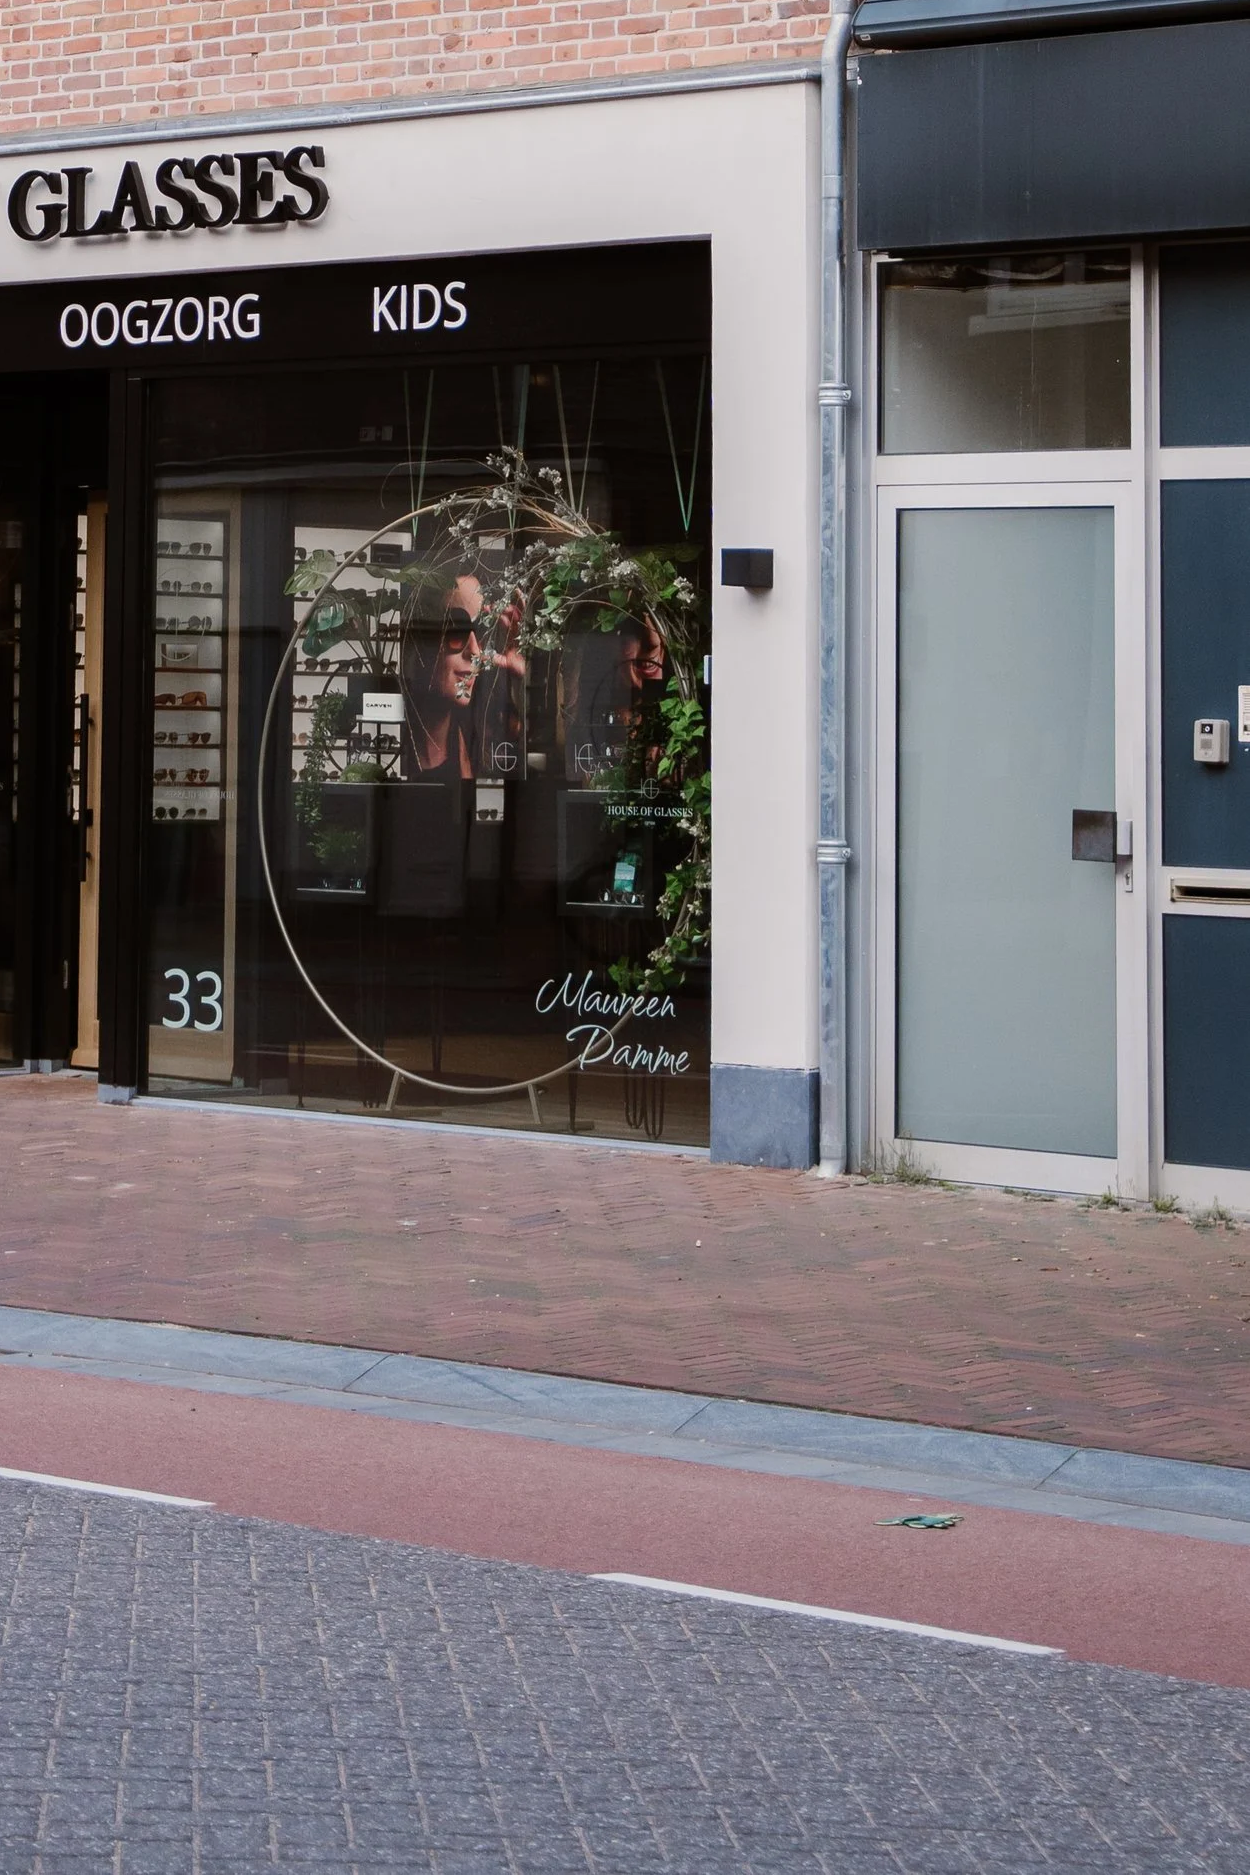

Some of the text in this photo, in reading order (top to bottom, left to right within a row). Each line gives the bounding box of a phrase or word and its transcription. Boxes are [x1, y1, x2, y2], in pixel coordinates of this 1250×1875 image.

[7, 145, 330, 243] GLASSES
[59, 292, 262, 349] OOGZORG
[372, 280, 469, 333] KIDS
[607, 805, 694, 818] HOUSE OF GLASSES
[161, 967, 223, 1032] 33
[535, 969, 676, 1018] Maureen
[565, 1024, 690, 1075] Damme
